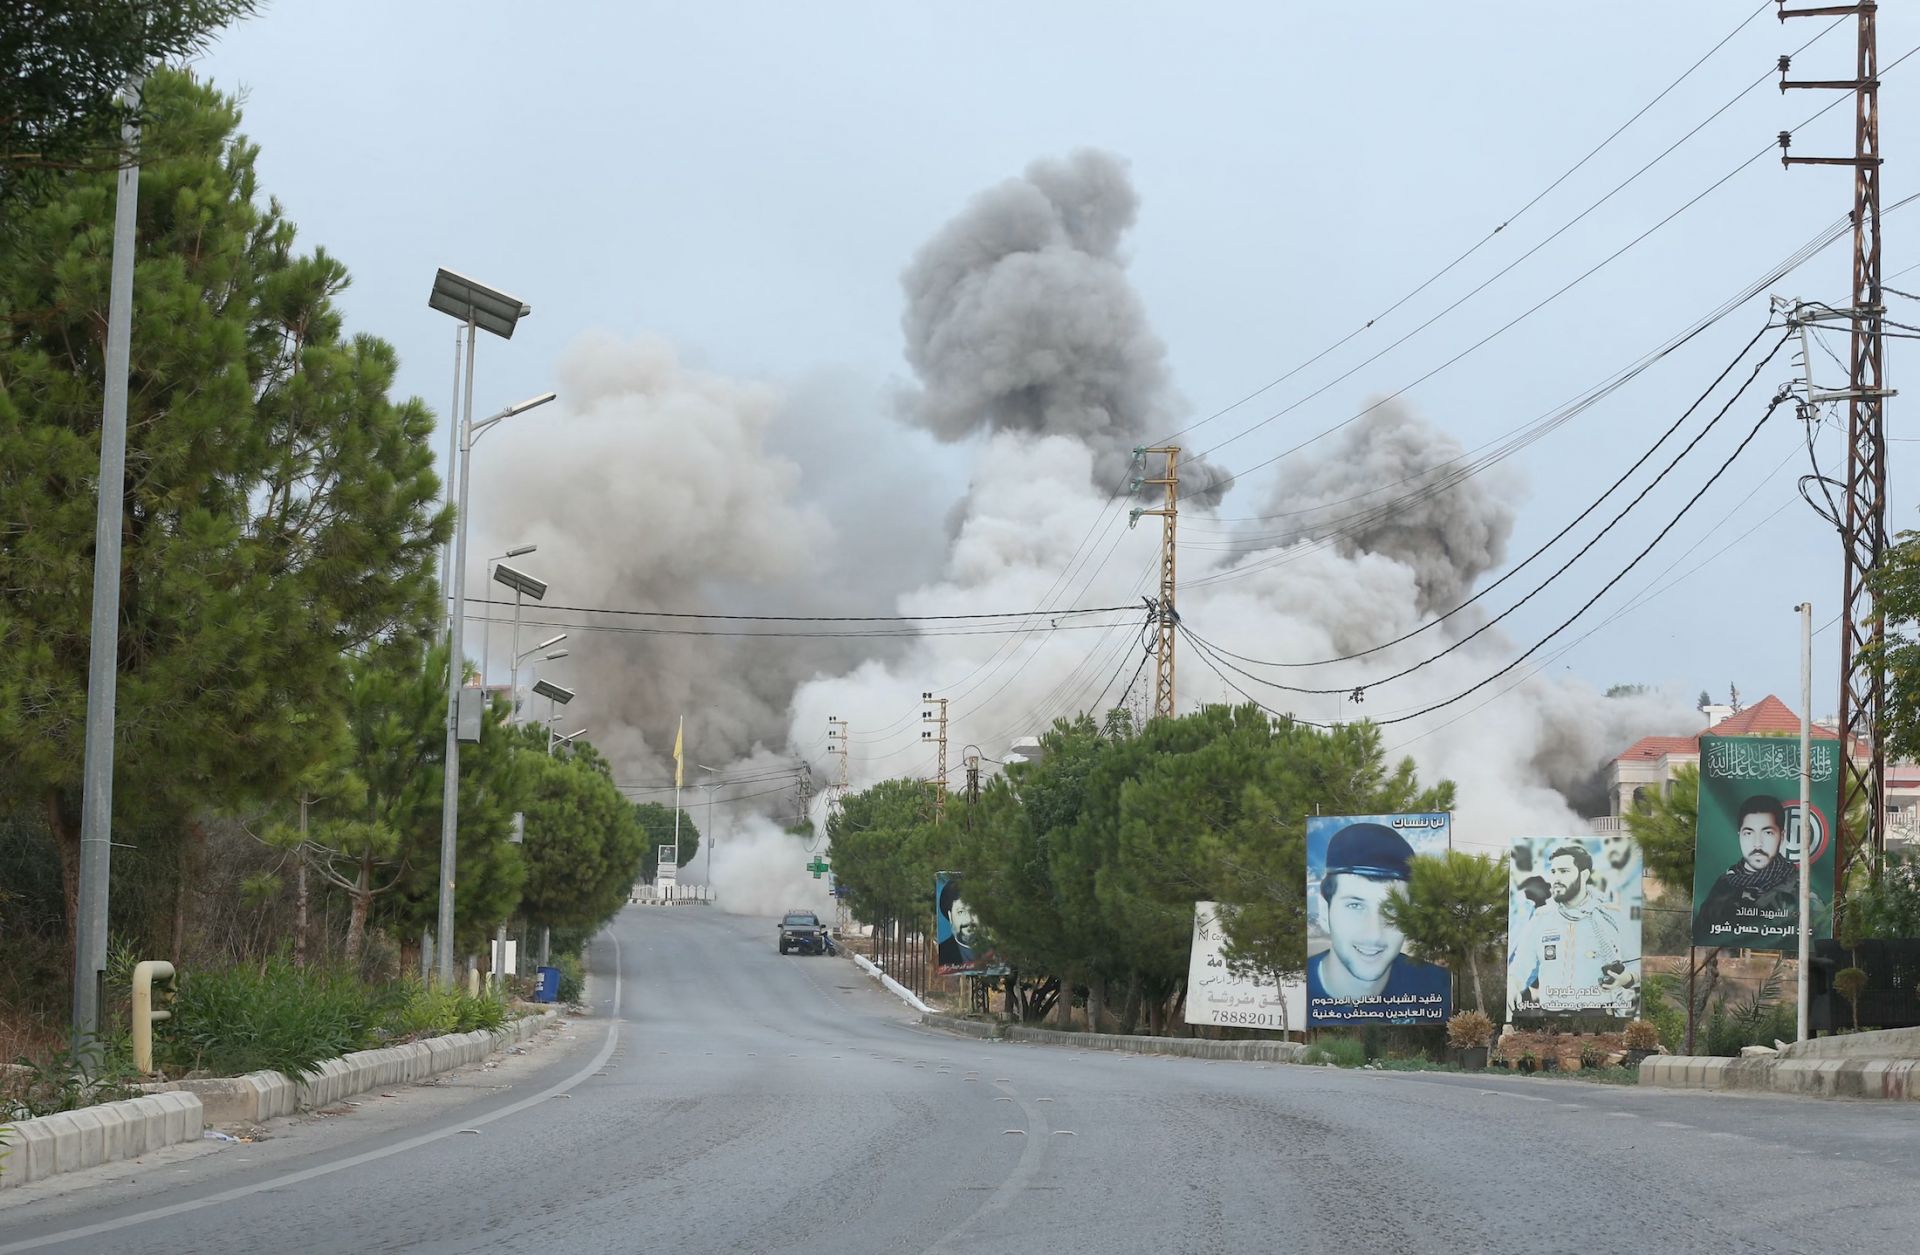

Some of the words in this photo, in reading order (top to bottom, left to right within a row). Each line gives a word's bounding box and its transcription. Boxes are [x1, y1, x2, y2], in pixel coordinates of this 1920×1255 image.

[1431, 817, 1444, 828] لن
[1736, 906, 1758, 917] القائد
[1760, 908, 1788, 919] الشهيد
[1710, 921, 1731, 934] شور
[1734, 923, 1759, 935] حسن
[1761, 924, 1795, 936] الرحمن
[1797, 927, 1813, 936] عد
[1576, 986, 1600, 998] خادم
[1208, 991, 1255, 1007] مفروشة
[1312, 995, 1351, 1006] المرحوم
[1352, 994, 1382, 1007] الغالي
[1383, 993, 1417, 1004] الشباب
[1419, 994, 1442, 1004] فقيد
[1601, 1000, 1632, 1010] الشهيد
[1212, 1010, 1283, 1026] 78882011
[1312, 1009, 1342, 1019] مغنية
[1344, 1008, 1384, 1019] مصطفى
[1385, 1008, 1425, 1019] العابدين
[1426, 1007, 1442, 1018] زين
